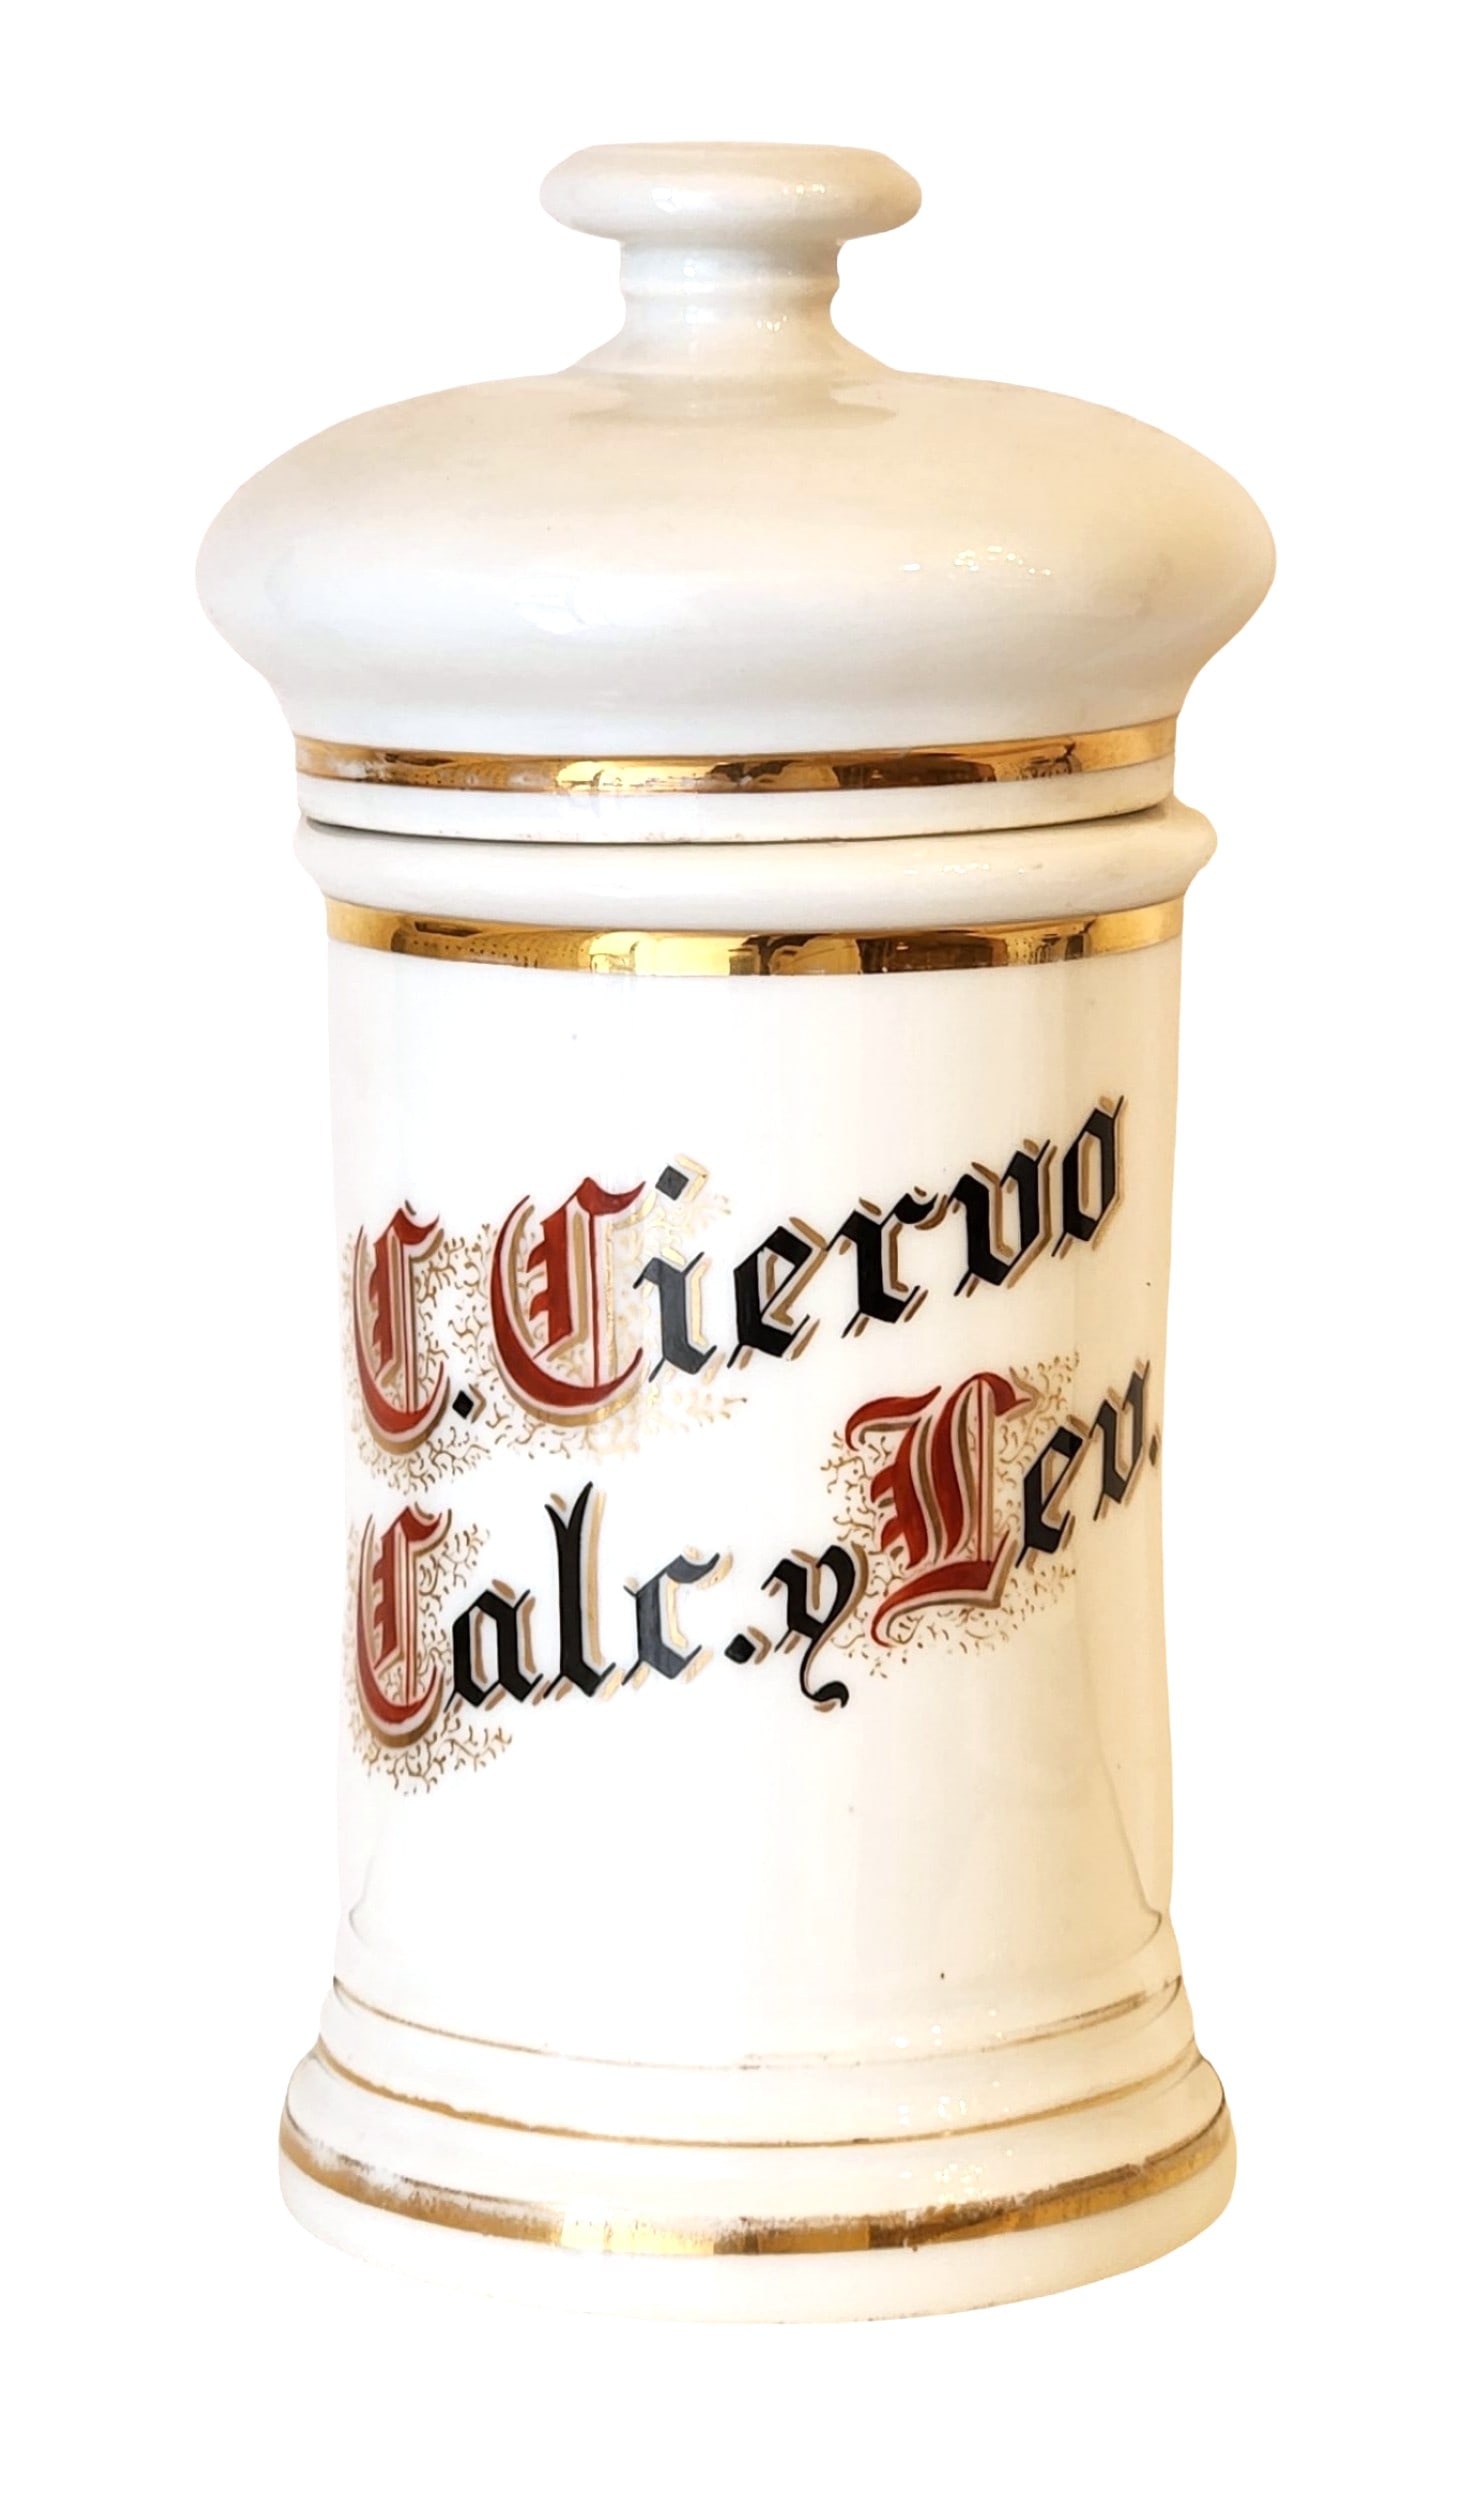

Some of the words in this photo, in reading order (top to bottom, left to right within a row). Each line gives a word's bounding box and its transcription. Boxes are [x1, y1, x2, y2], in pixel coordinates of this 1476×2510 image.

[352, 1202, 484, 1450] C.
[490, 1096, 1125, 1422] Ciervo
[356, 1482, 768, 1742] Calc.
[761, 1544, 868, 1710] y
[844, 1361, 1161, 1648] Lev.
